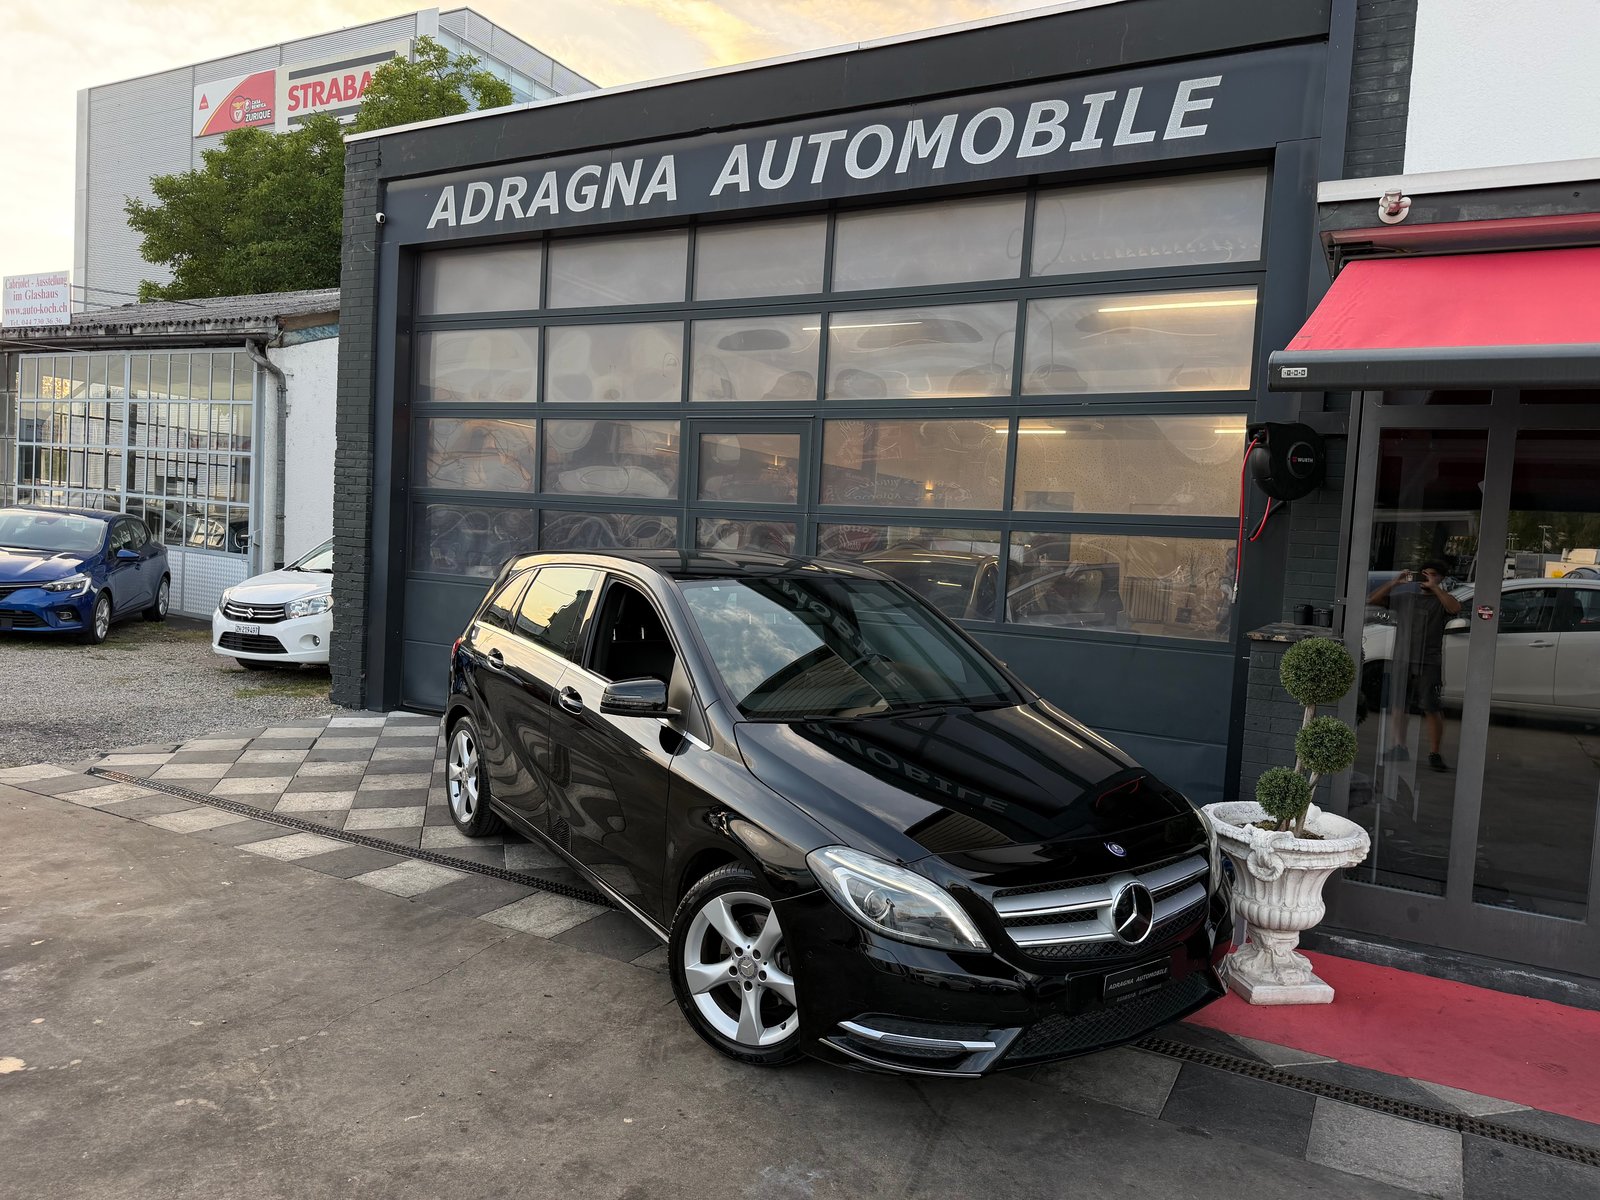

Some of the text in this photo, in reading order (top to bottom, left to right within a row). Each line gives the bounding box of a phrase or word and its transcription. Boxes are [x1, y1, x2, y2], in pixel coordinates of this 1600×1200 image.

[288, 70, 373, 112] STRABA
[246, 110, 271, 122] ZURIQUE
[426, 75, 1222, 229] ADRAGNA AUTOMOBILE
[14, 289, 58, 300] im Glashaus
[5, 302, 68, 315] www.auto-koch.ch
